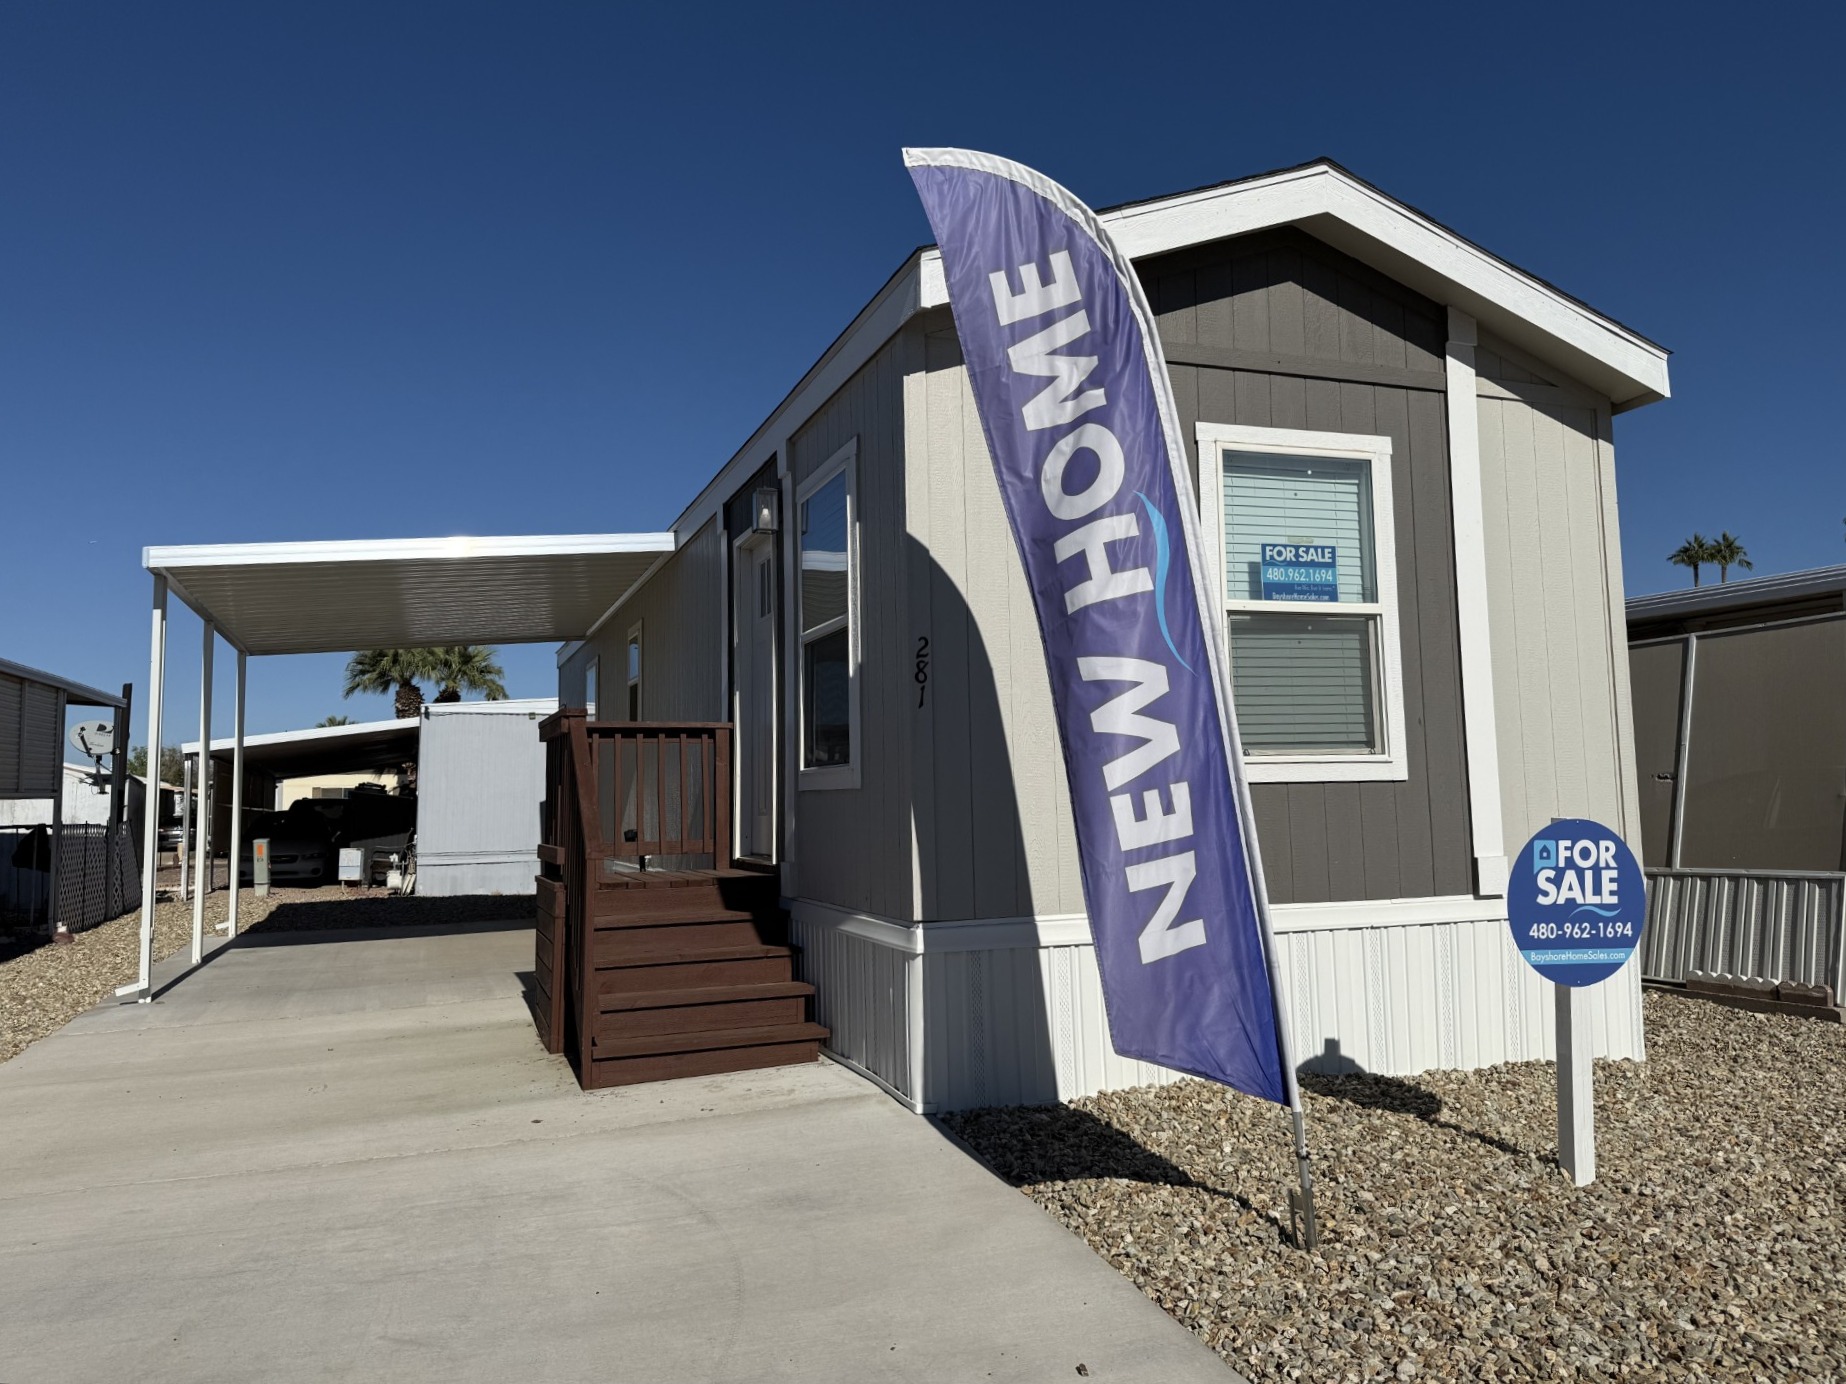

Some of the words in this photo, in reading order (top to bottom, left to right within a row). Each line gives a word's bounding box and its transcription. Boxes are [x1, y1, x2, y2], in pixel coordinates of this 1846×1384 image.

[988, 250, 1155, 615] HOME
[1265, 546, 1296, 561] FOR
[1299, 547, 1332, 562] SALE
[1266, 568, 1333, 582] 480.962.1694
[914, 636, 929, 709] 281
[1076, 656, 1207, 965] NEW
[1557, 839, 1618, 868] FOR
[1536, 869, 1619, 905] SALE
[1529, 922, 1633, 939] 480-962-1694
[1530, 950, 1626, 963] BayshoreHomeSales.com
